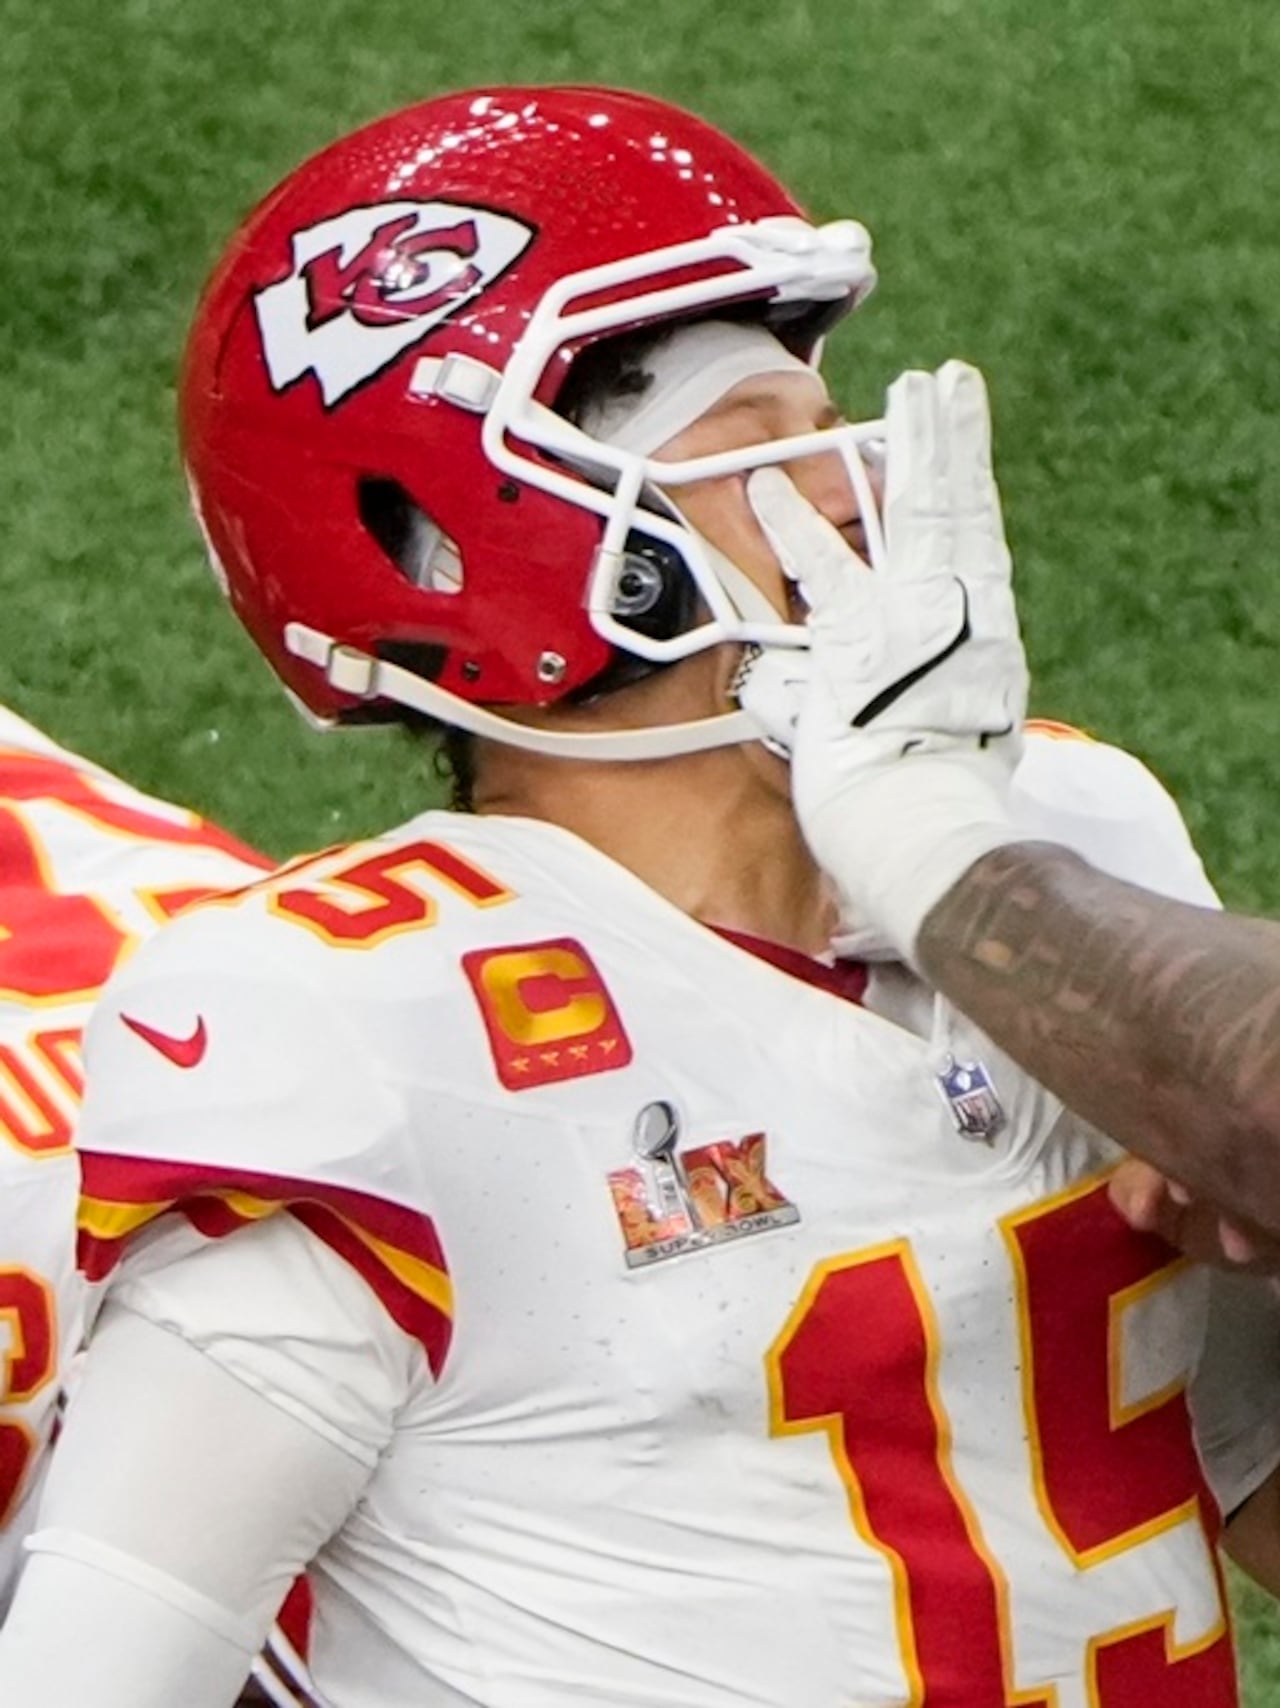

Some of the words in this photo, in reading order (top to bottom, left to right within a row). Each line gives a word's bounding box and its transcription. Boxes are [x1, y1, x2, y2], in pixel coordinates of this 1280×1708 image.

[299, 211, 483, 332] KC
[266, 838, 518, 950] 5
[481, 949, 606, 1045] C
[765, 1160, 1240, 1708] 15
